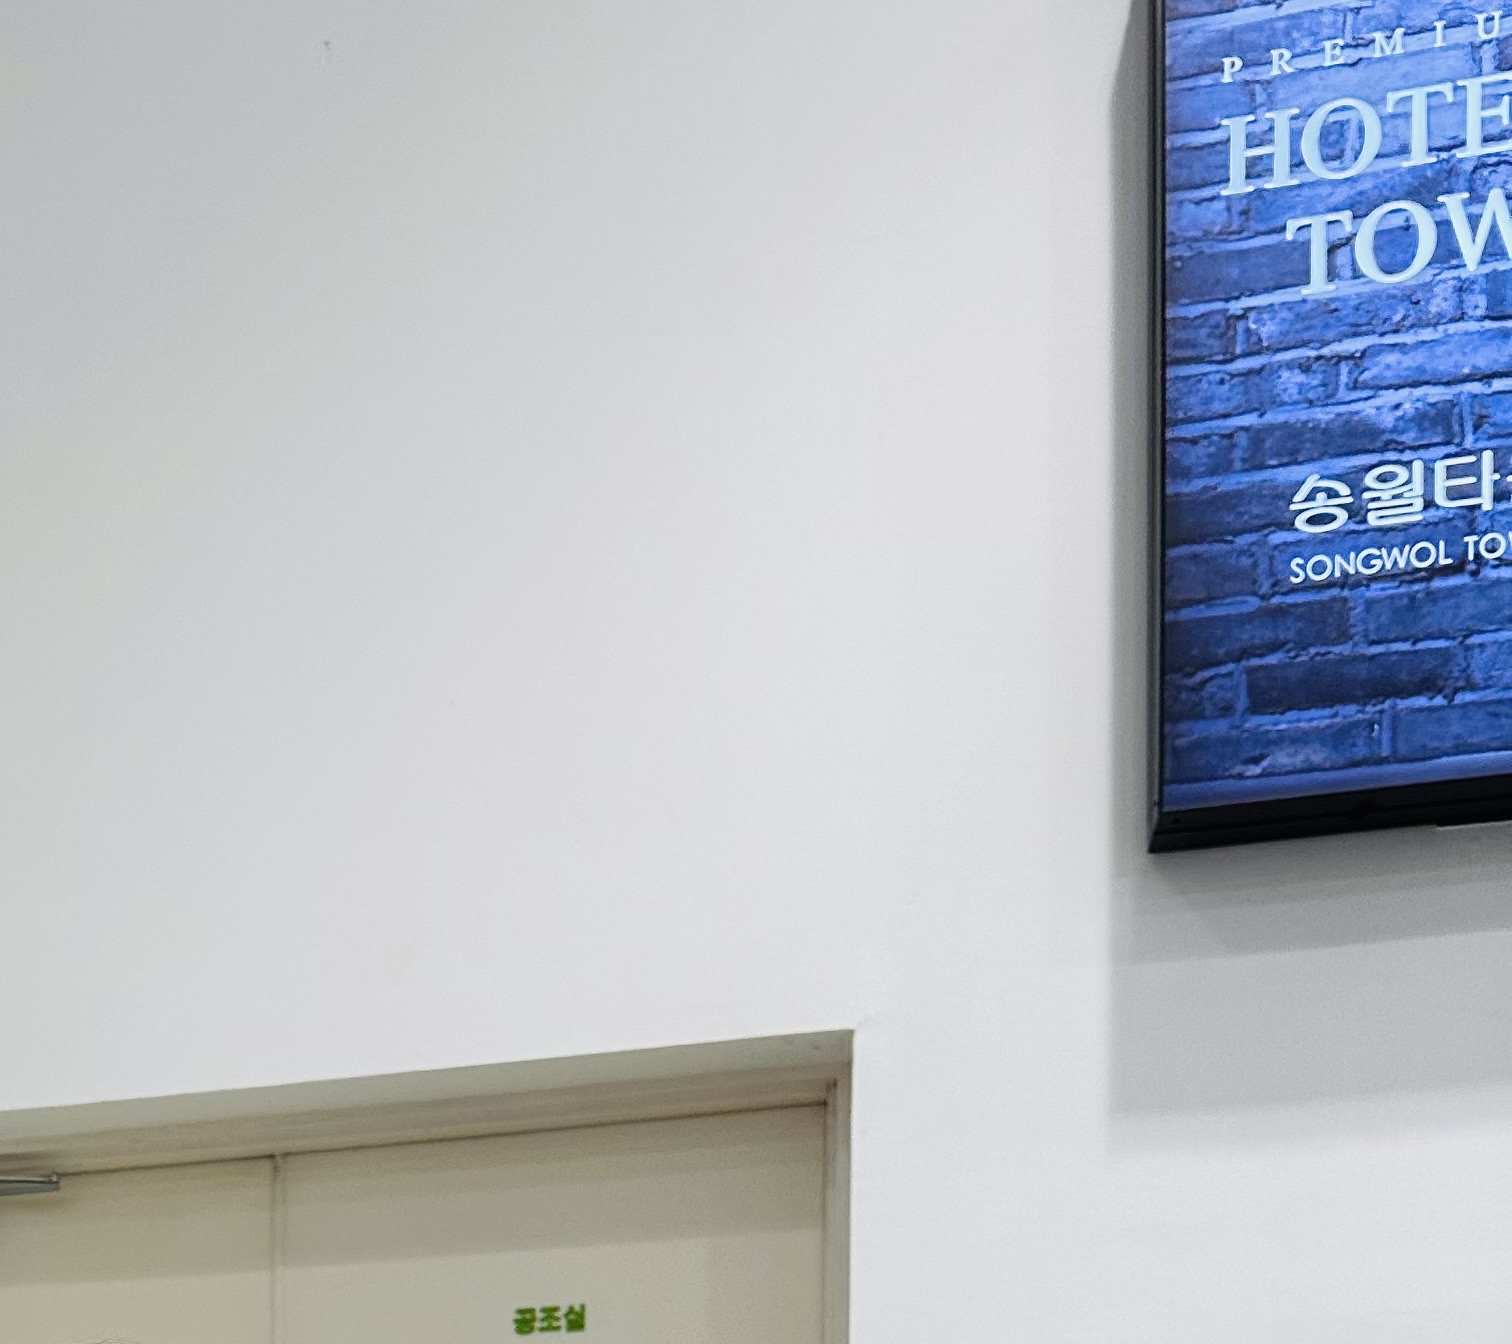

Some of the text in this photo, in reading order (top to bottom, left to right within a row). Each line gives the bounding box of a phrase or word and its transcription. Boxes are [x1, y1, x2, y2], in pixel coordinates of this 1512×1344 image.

[1221, 9, 1504, 84] PREMIU
[1220, 71, 1512, 196] HOTE
[1285, 187, 1512, 295] TOW
[1289, 449, 1512, 533] 송월타
[1289, 531, 1512, 584] SONGWOL TO
[513, 1303, 586, 1335] 공조실
